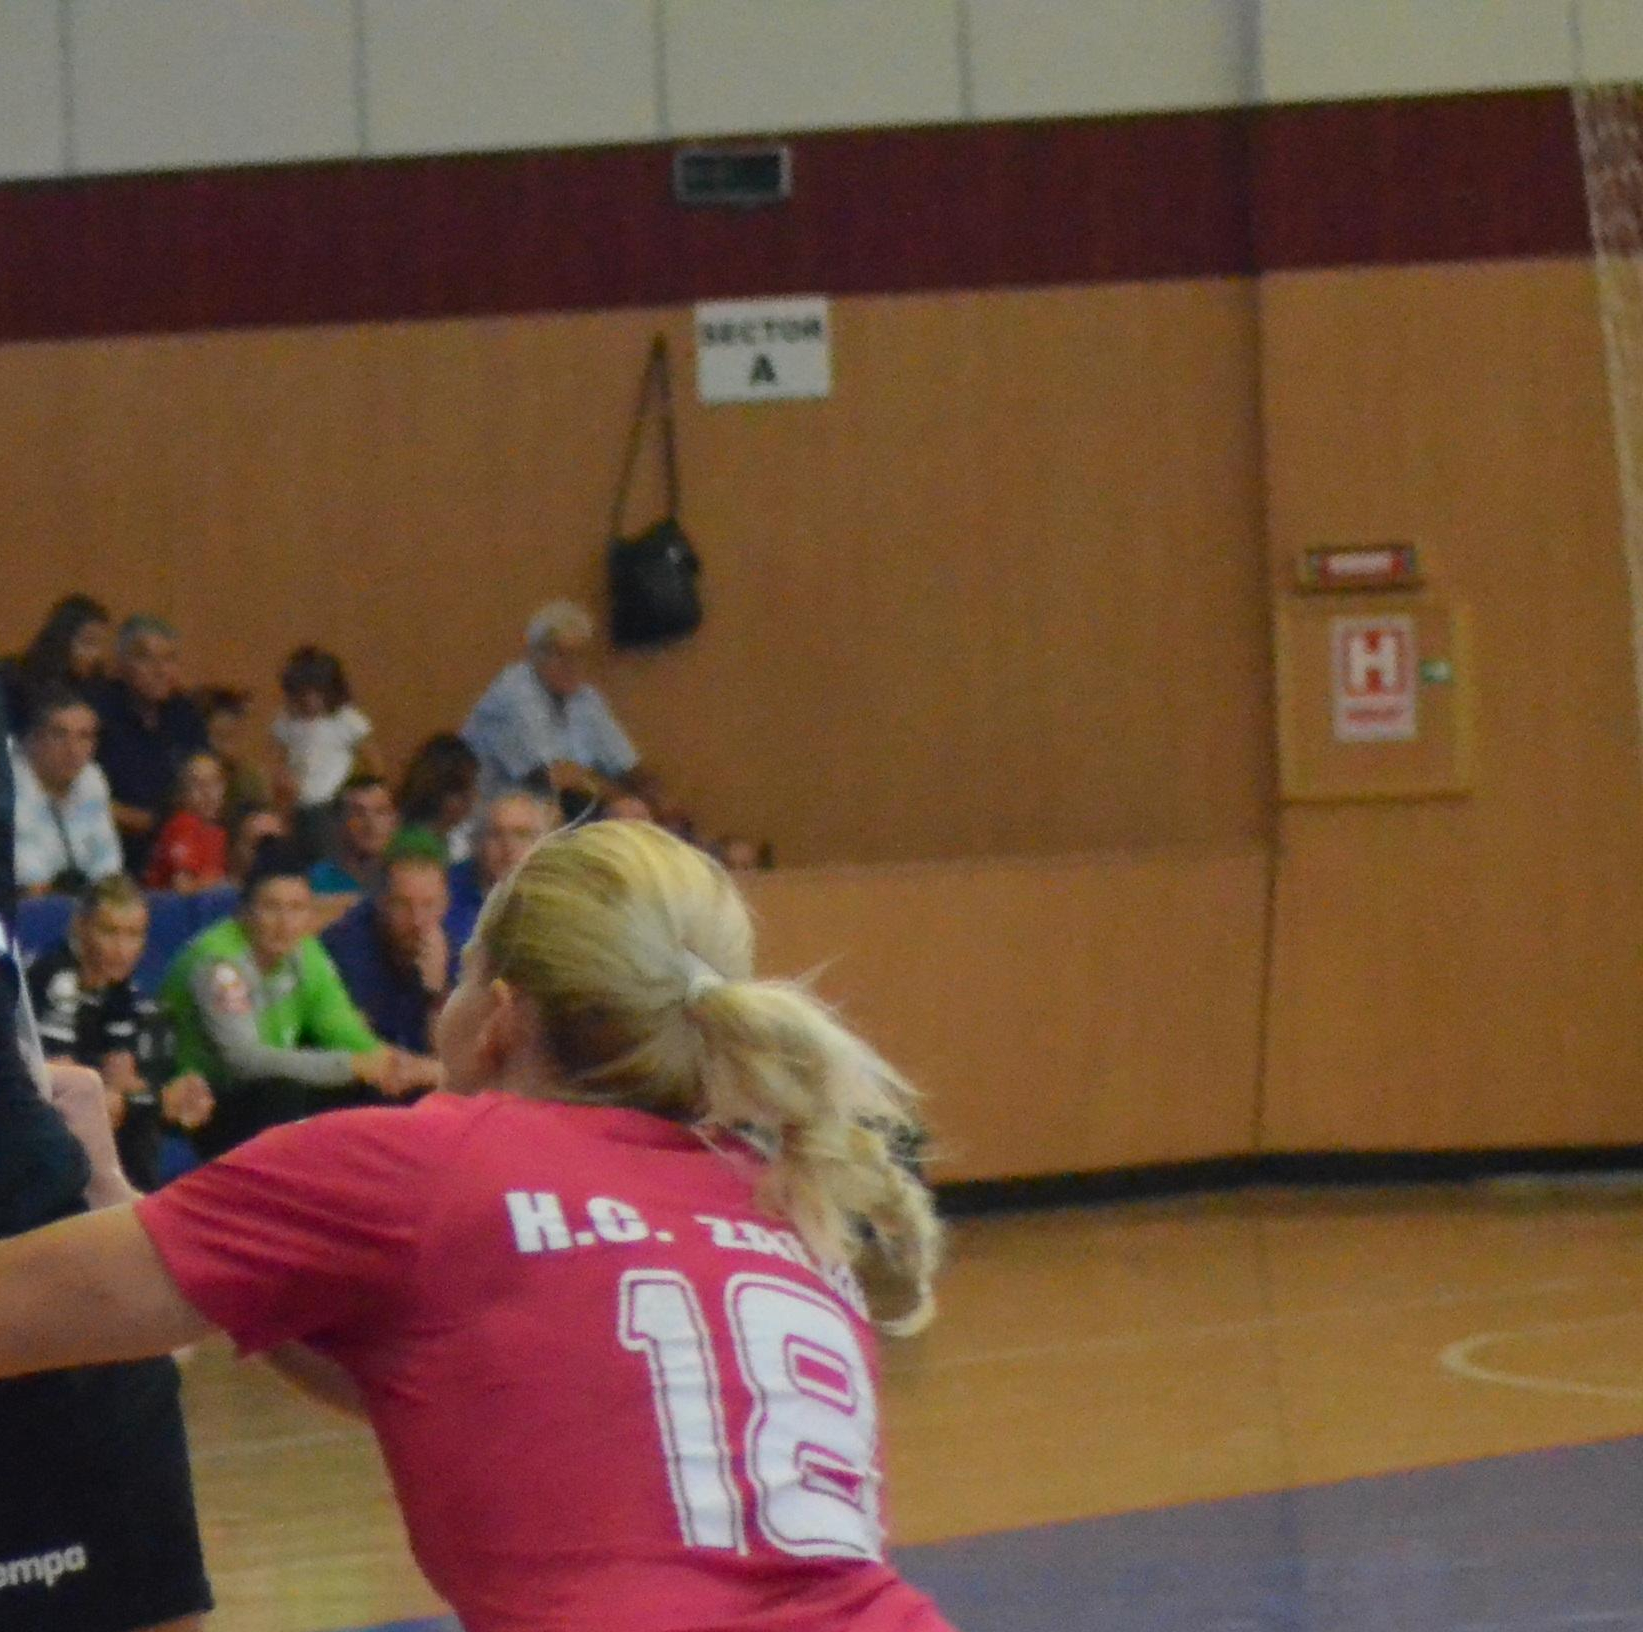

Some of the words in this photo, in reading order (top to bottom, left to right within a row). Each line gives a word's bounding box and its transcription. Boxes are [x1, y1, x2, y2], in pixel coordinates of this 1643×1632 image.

[701, 317, 823, 345] SECTOR
[749, 352, 778, 387] A
[1348, 633, 1398, 689] H
[617, 1267, 883, 1563] 18
